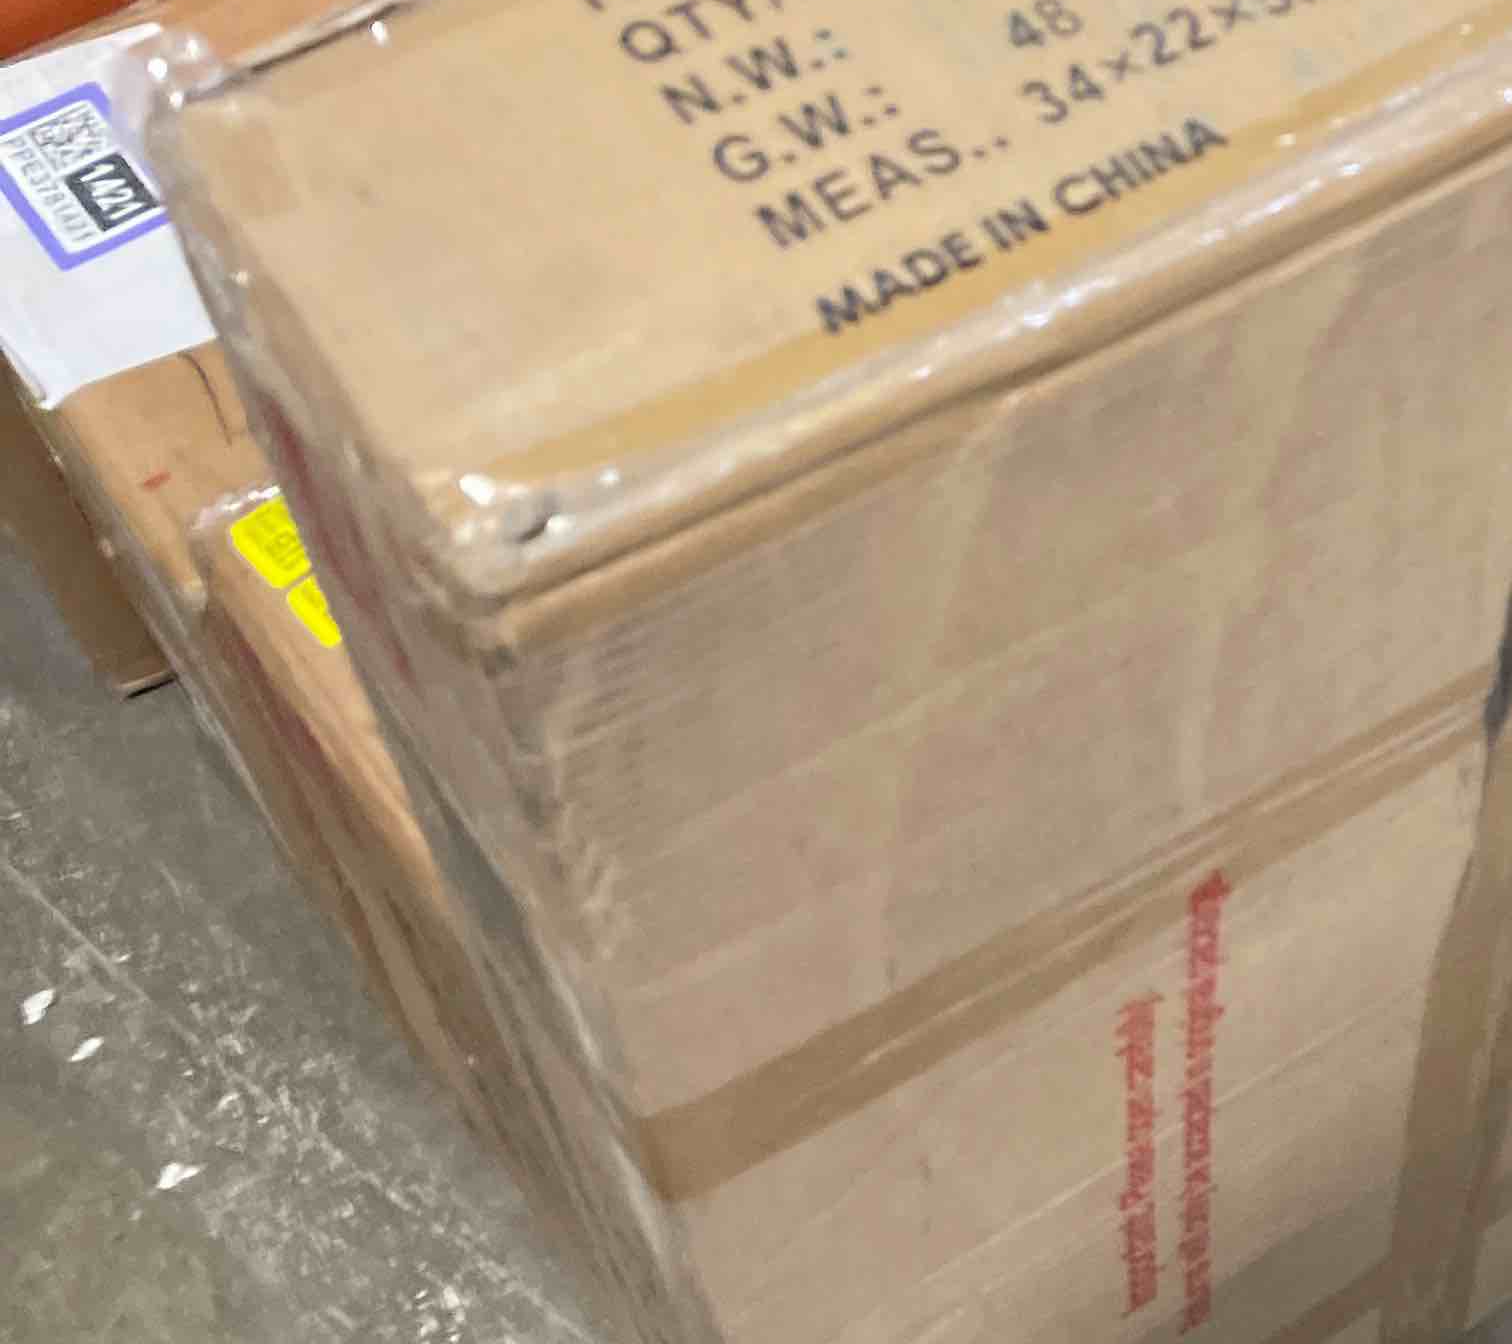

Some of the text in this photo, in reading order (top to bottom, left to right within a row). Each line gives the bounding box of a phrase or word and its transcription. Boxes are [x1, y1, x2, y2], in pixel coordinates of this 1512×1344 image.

[660, 27, 849, 126] N.W.:
[712, 84, 901, 185] G.W.:
[80, 163, 147, 220] 1421
[815, 117, 1229, 335] MADE IN CHINA
